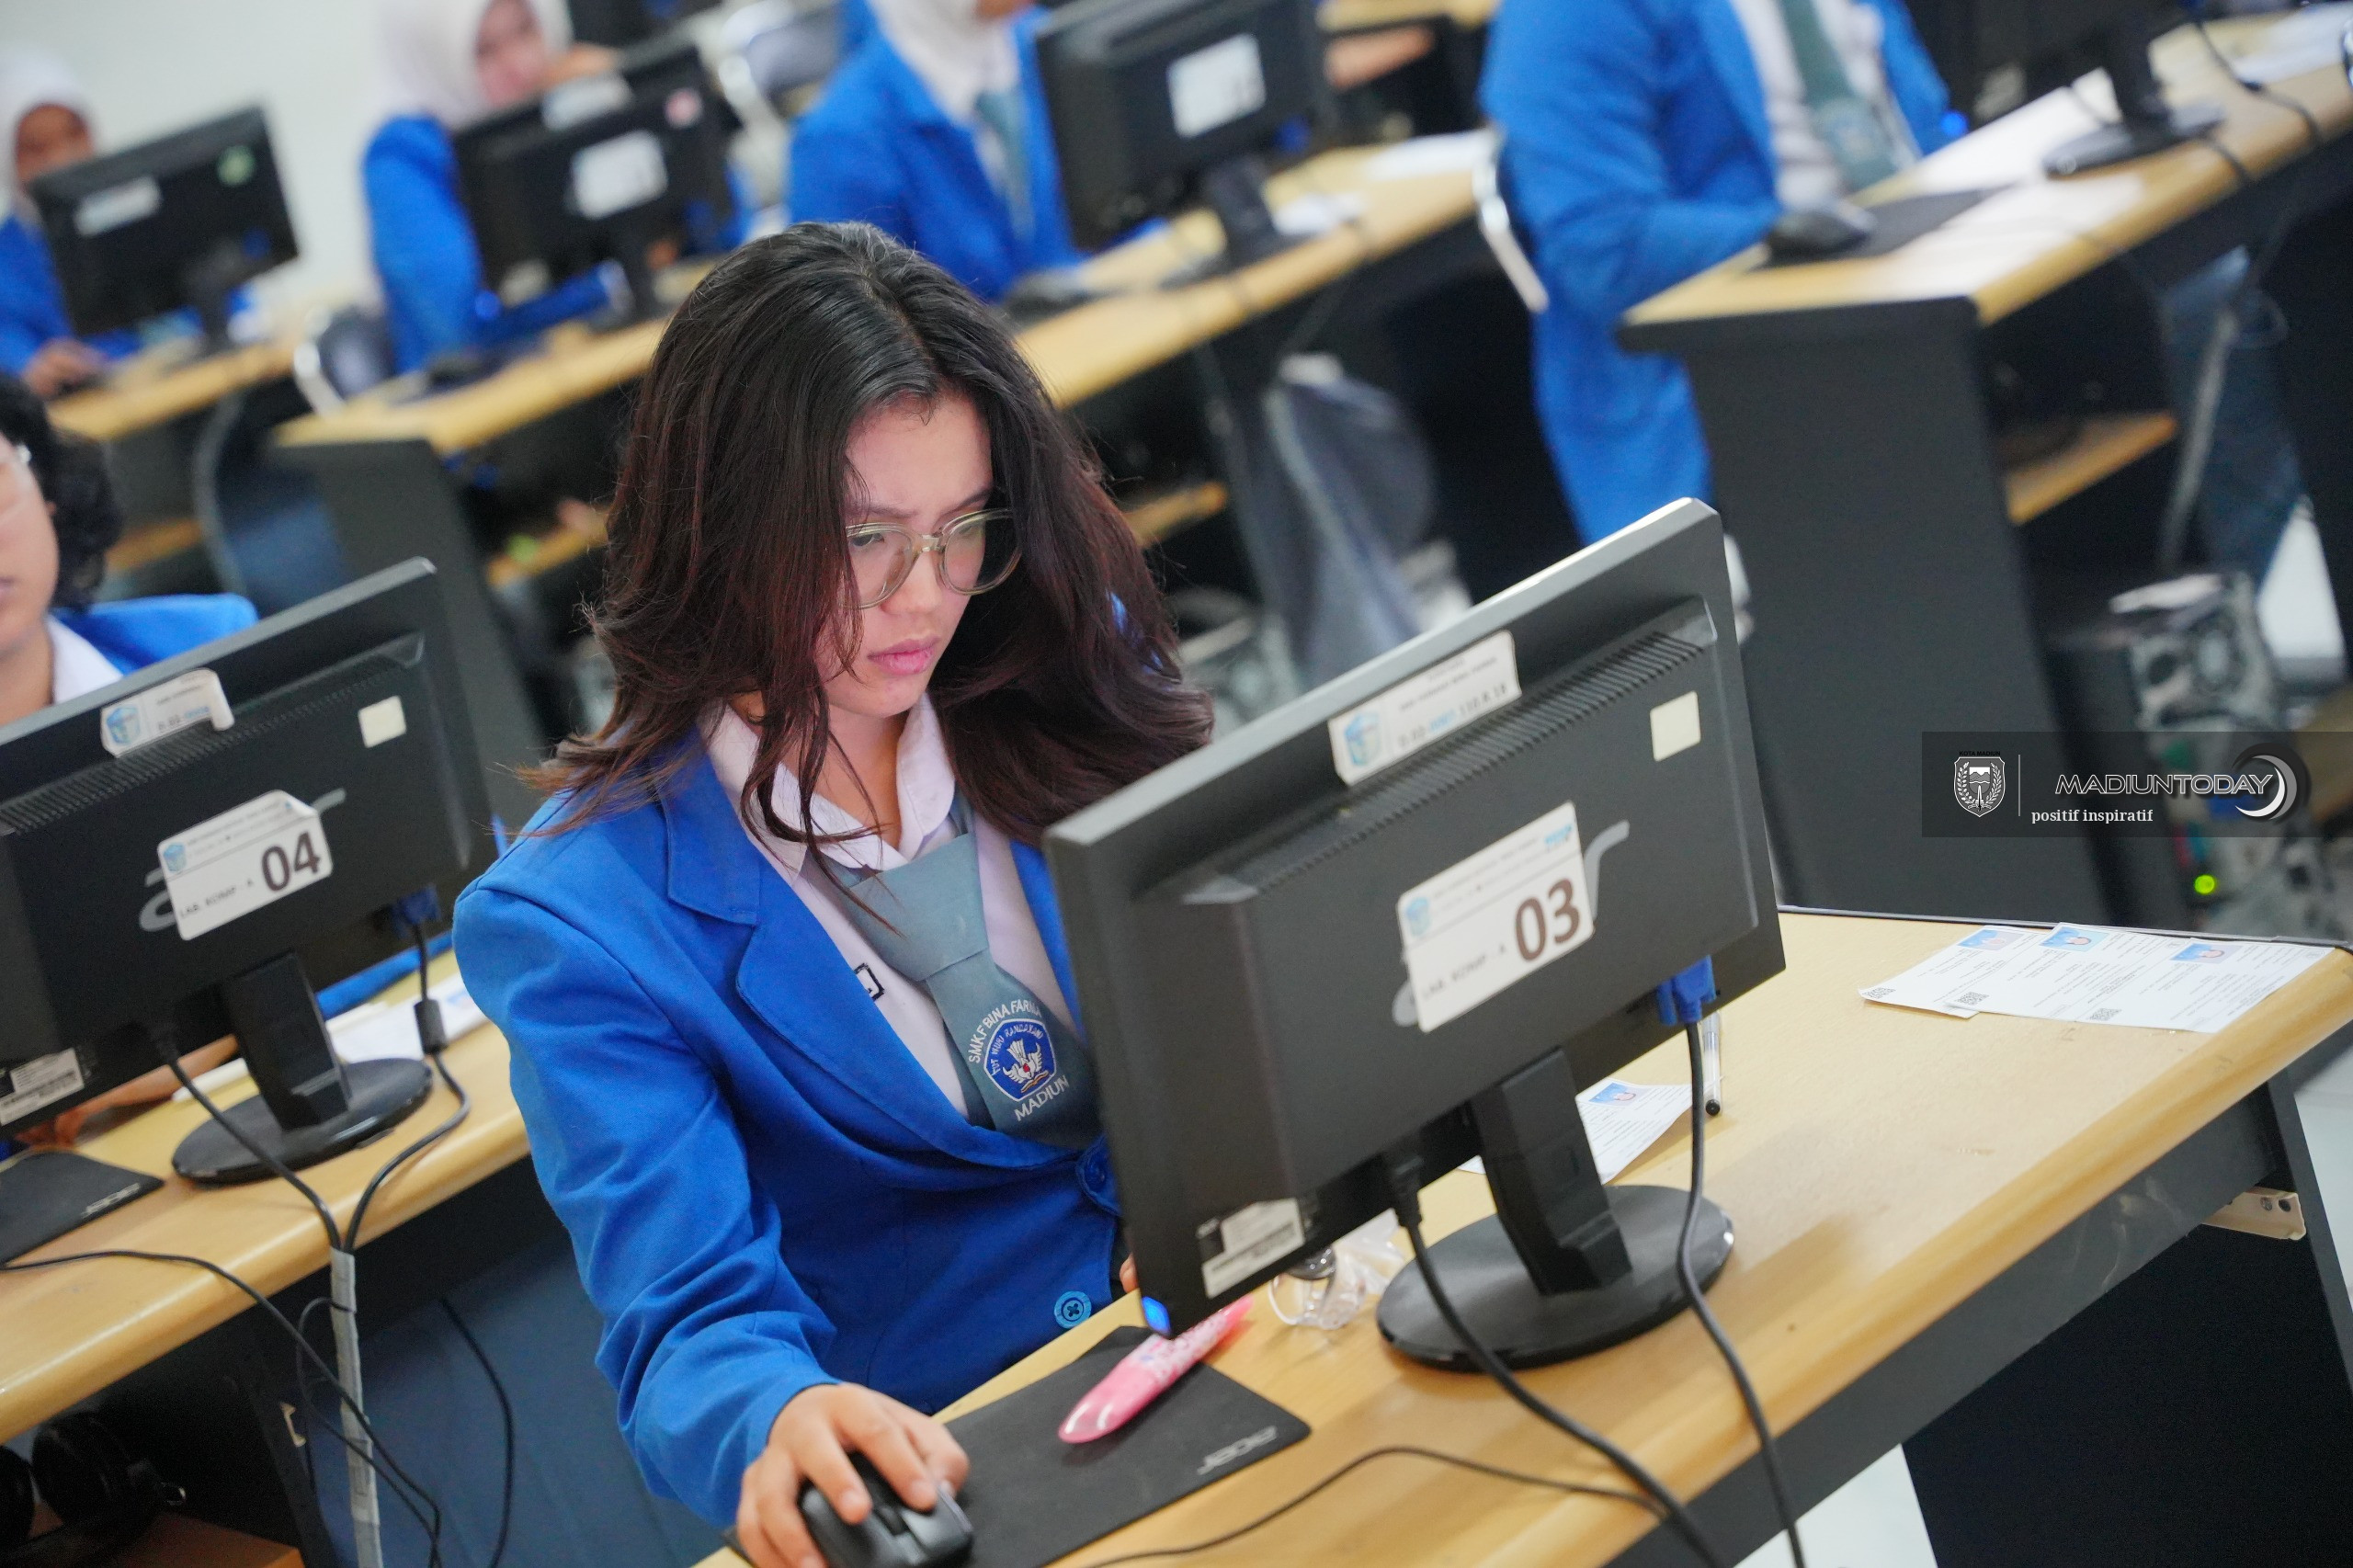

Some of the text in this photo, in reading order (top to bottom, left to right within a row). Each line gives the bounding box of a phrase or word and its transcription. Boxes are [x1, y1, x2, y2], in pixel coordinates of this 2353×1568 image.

[261, 831, 321, 892] 04
[1515, 878, 1580, 961] 03
[983, 1004, 1011, 1028] BINA
[1014, 1074, 1070, 1121] MADIUN
